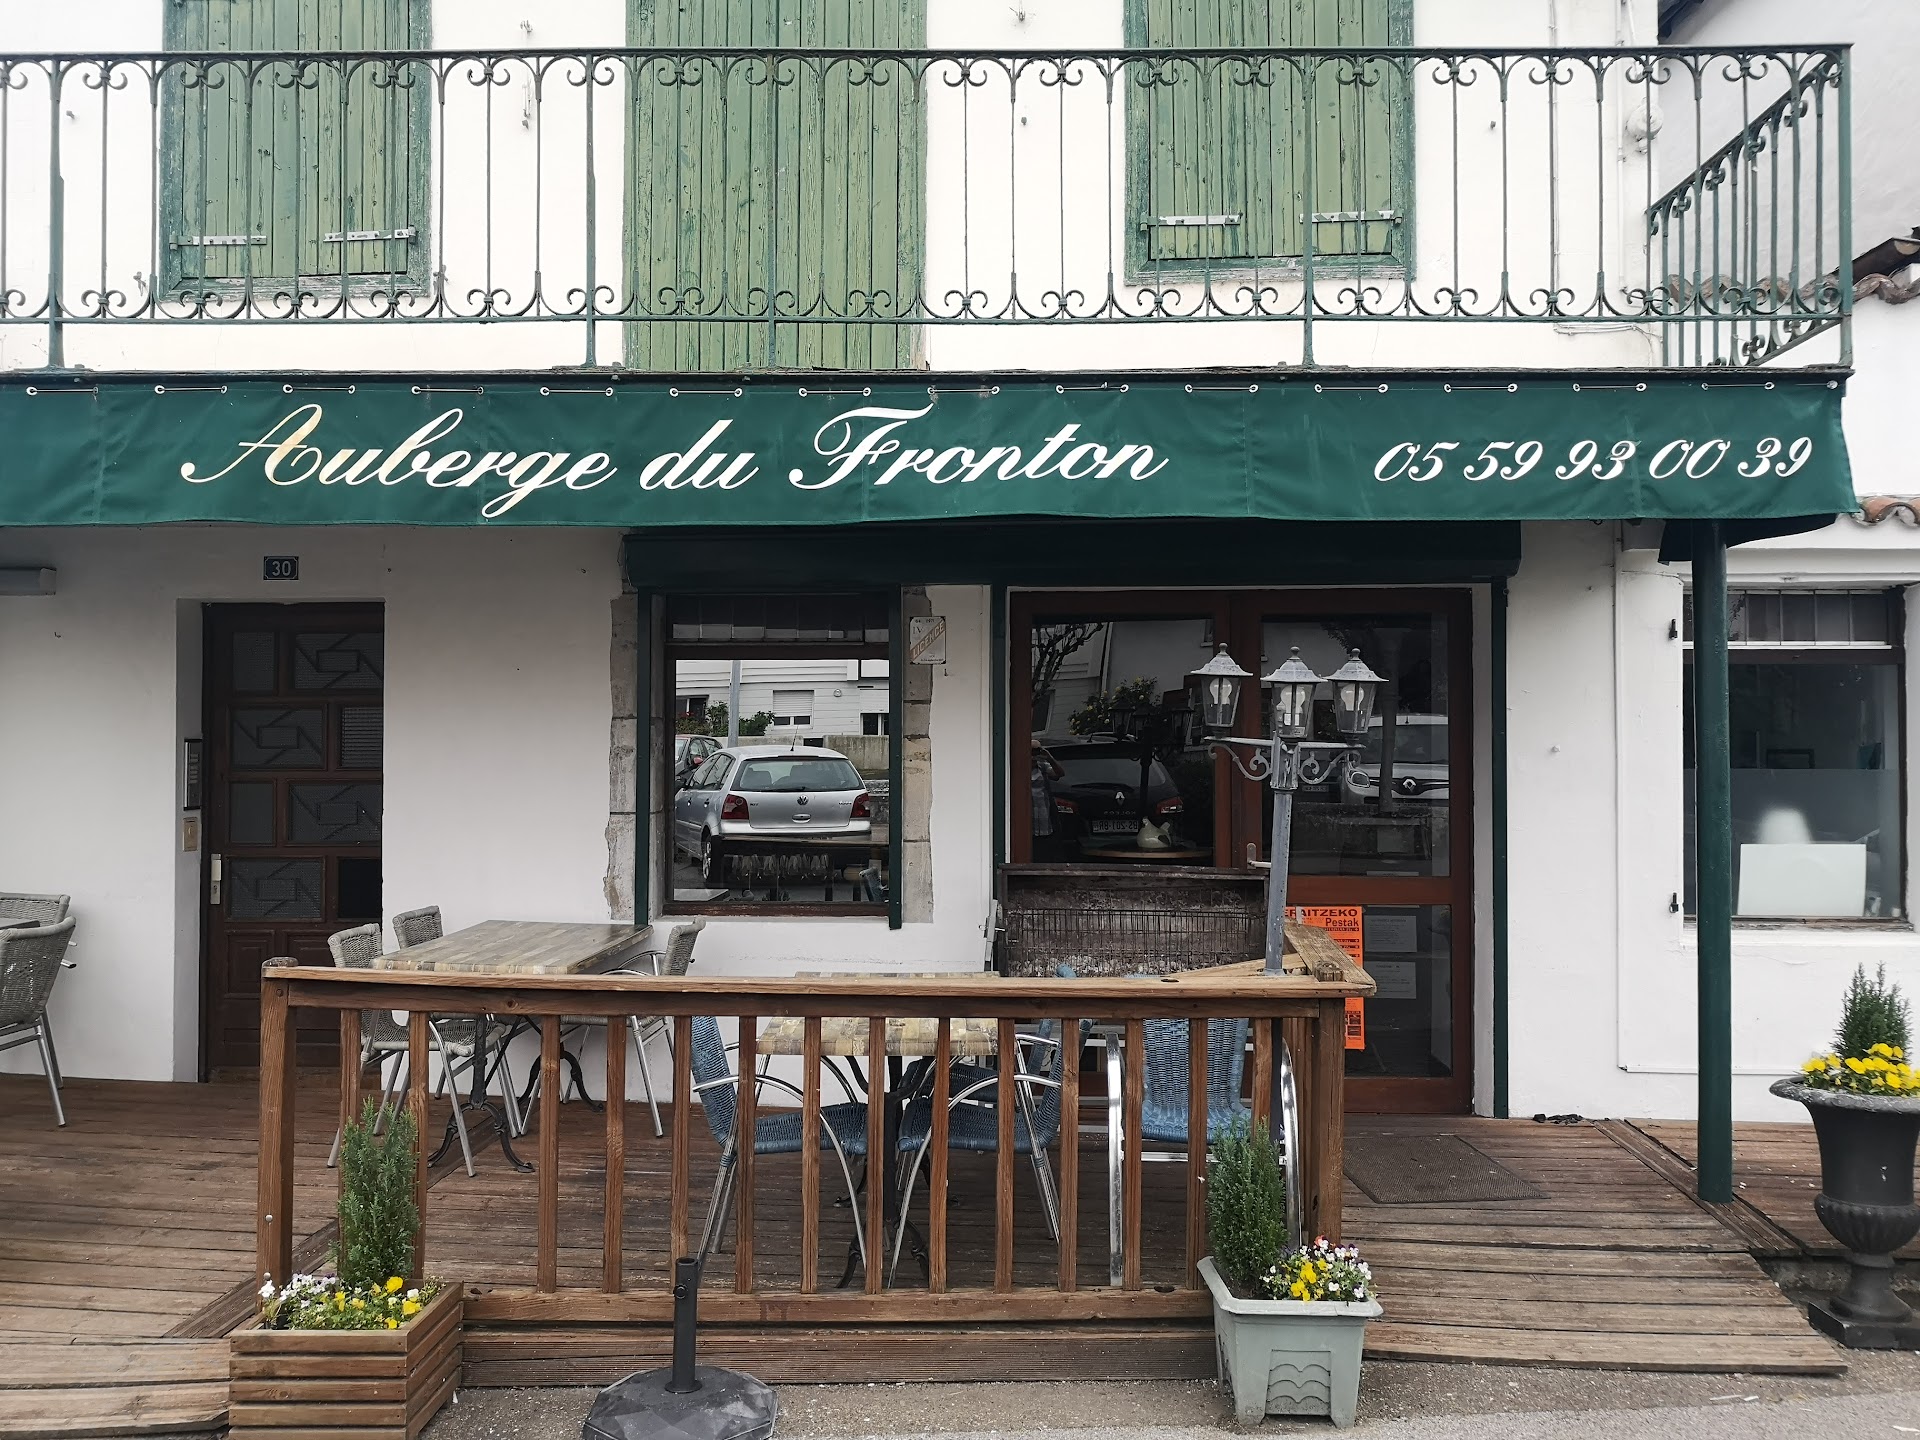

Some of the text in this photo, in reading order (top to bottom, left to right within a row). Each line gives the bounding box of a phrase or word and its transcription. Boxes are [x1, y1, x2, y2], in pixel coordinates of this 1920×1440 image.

[181, 402, 1170, 519] Auberge du Fronton
[1374, 436, 1813, 482] 05 59 93 00 39
[271, 560, 292, 577] 30
[912, 619, 945, 659] LICENCE
[1325, 917, 1360, 927] Pestak
